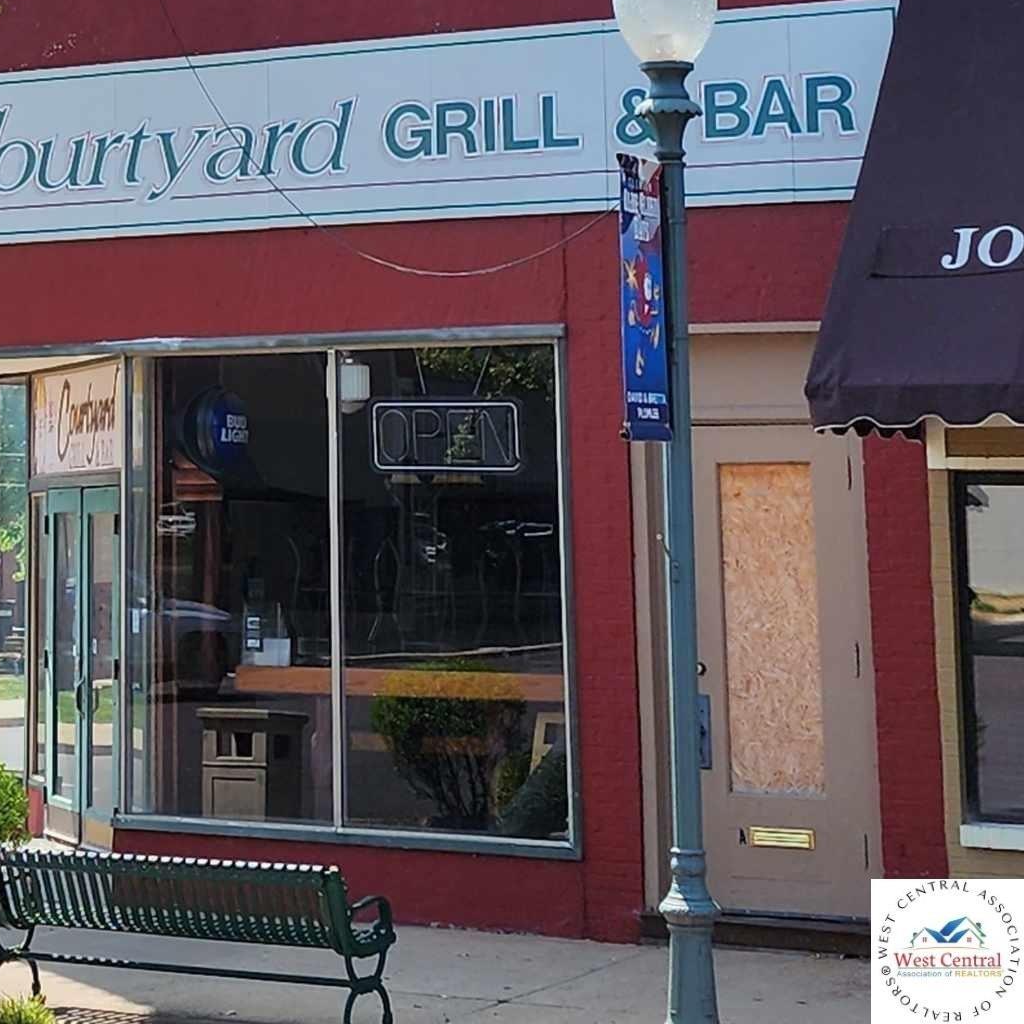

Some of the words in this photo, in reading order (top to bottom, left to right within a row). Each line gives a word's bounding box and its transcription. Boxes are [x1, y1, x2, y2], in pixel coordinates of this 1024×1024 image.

[383, 93, 582, 159] GRILL
[701, 73, 859, 141] BAR
[940, 225, 1024, 269] JO
[57, 364, 120, 465] Courtyard
[226, 414, 248, 429] BUD
[379, 409, 513, 464] OPEN
